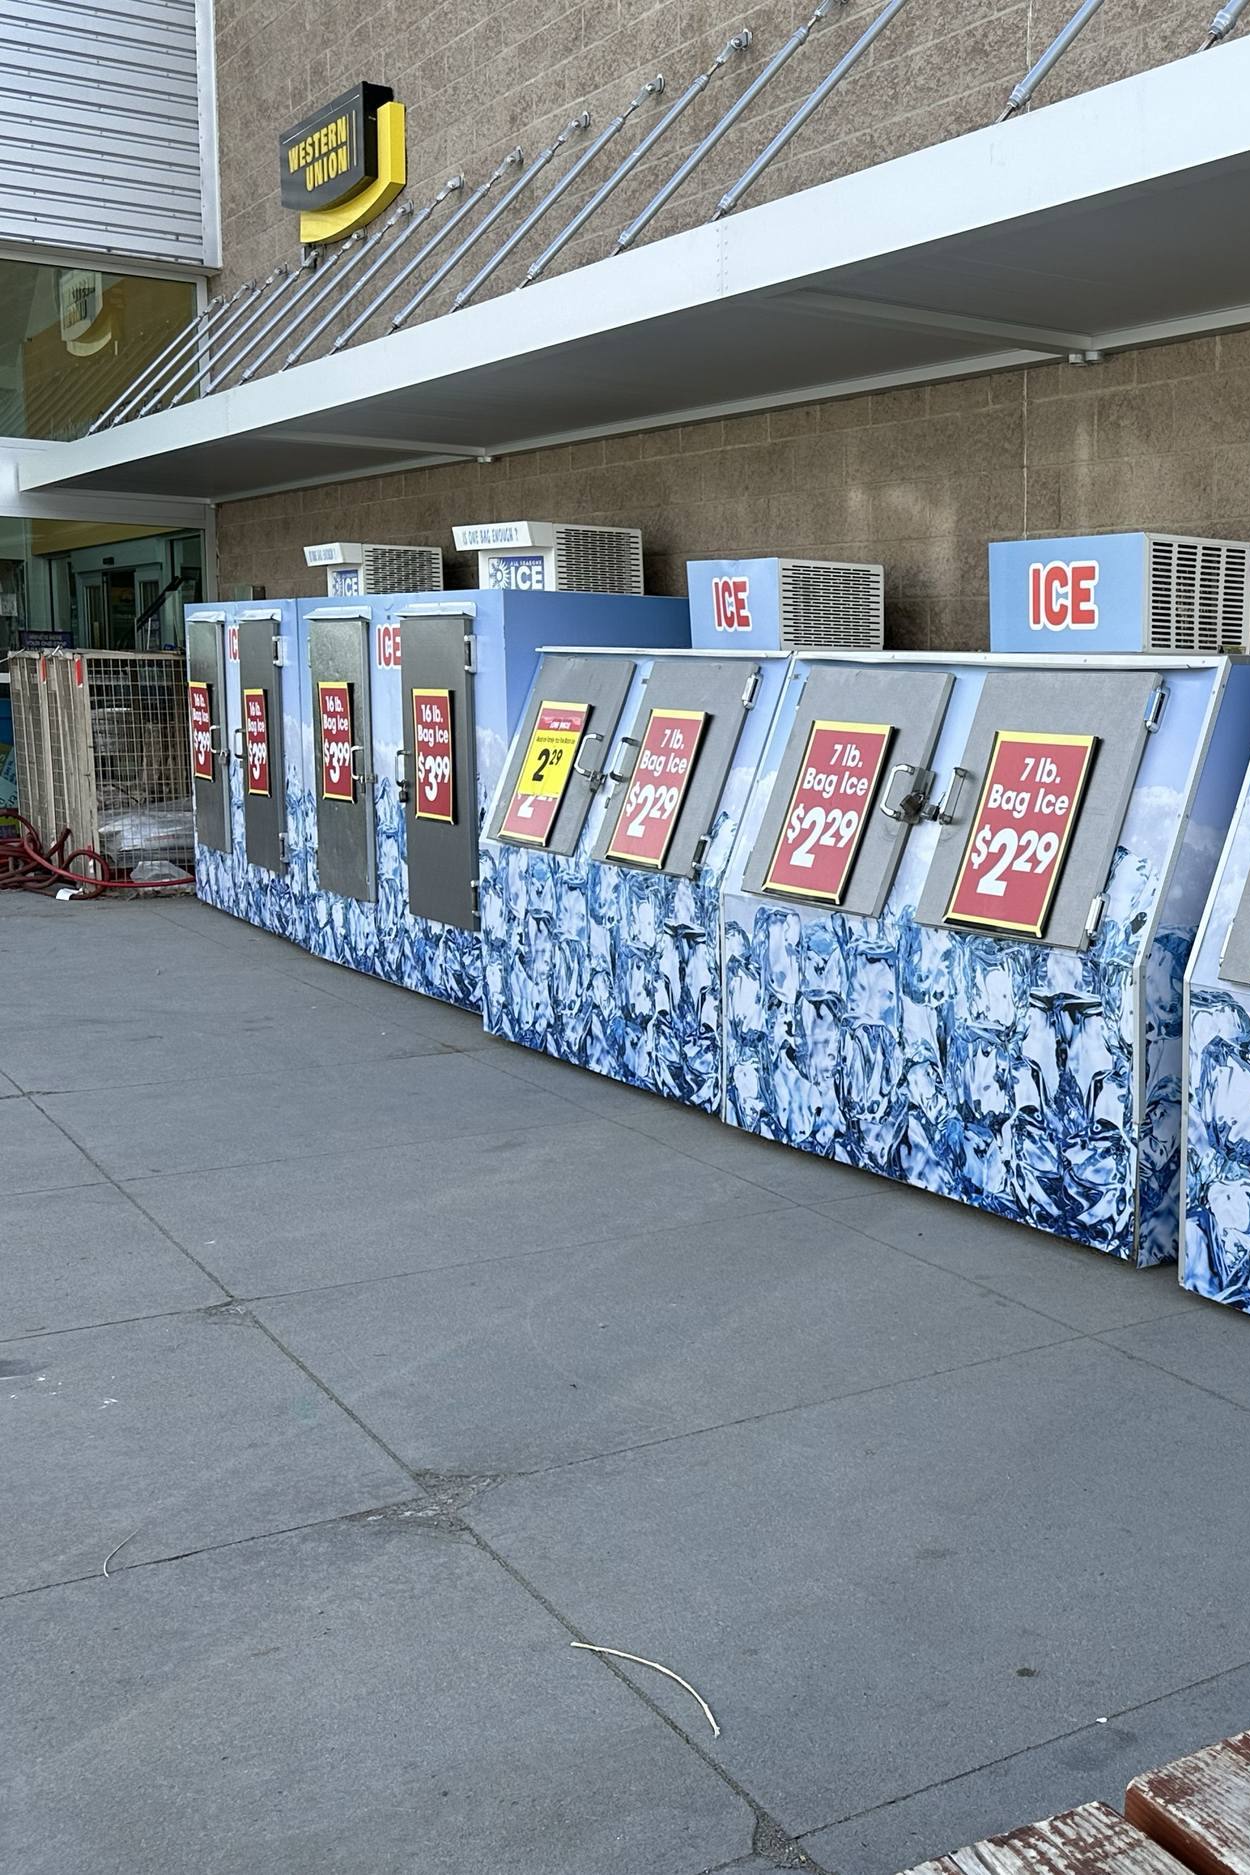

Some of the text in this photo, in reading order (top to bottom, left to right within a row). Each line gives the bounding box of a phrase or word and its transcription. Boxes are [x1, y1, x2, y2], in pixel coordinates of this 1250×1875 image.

[288, 116, 347, 174] WESTERN
[305, 146, 347, 191] UNION
[468, 529, 479, 545] ONE
[492, 527, 514, 543] ENOUGH
[342, 577, 358, 596] ICE
[510, 566, 543, 590] ICE
[713, 577, 751, 631] ICE
[1030, 562, 1098, 630] ICE
[228, 627, 240, 662] IC
[193, 693, 200, 707] 16
[249, 702, 256, 716] 16
[325, 696, 344, 712] 16 lb.
[192, 708, 202, 725] Bag
[324, 714, 349, 735] Bag Ice
[421, 704, 443, 722] 16 lb.
[248, 718, 265, 736] Bag Ice
[417, 724, 449, 747] Bag Ice
[661, 729, 685, 749] 7 lb.
[640, 749, 688, 776] Bag Ice
[829, 744, 863, 767] 7 lb.
[1019, 757, 1061, 784] 7 lb.
[802, 767, 869, 798] Bag Ice
[987, 784, 1069, 818] Bag Ice
